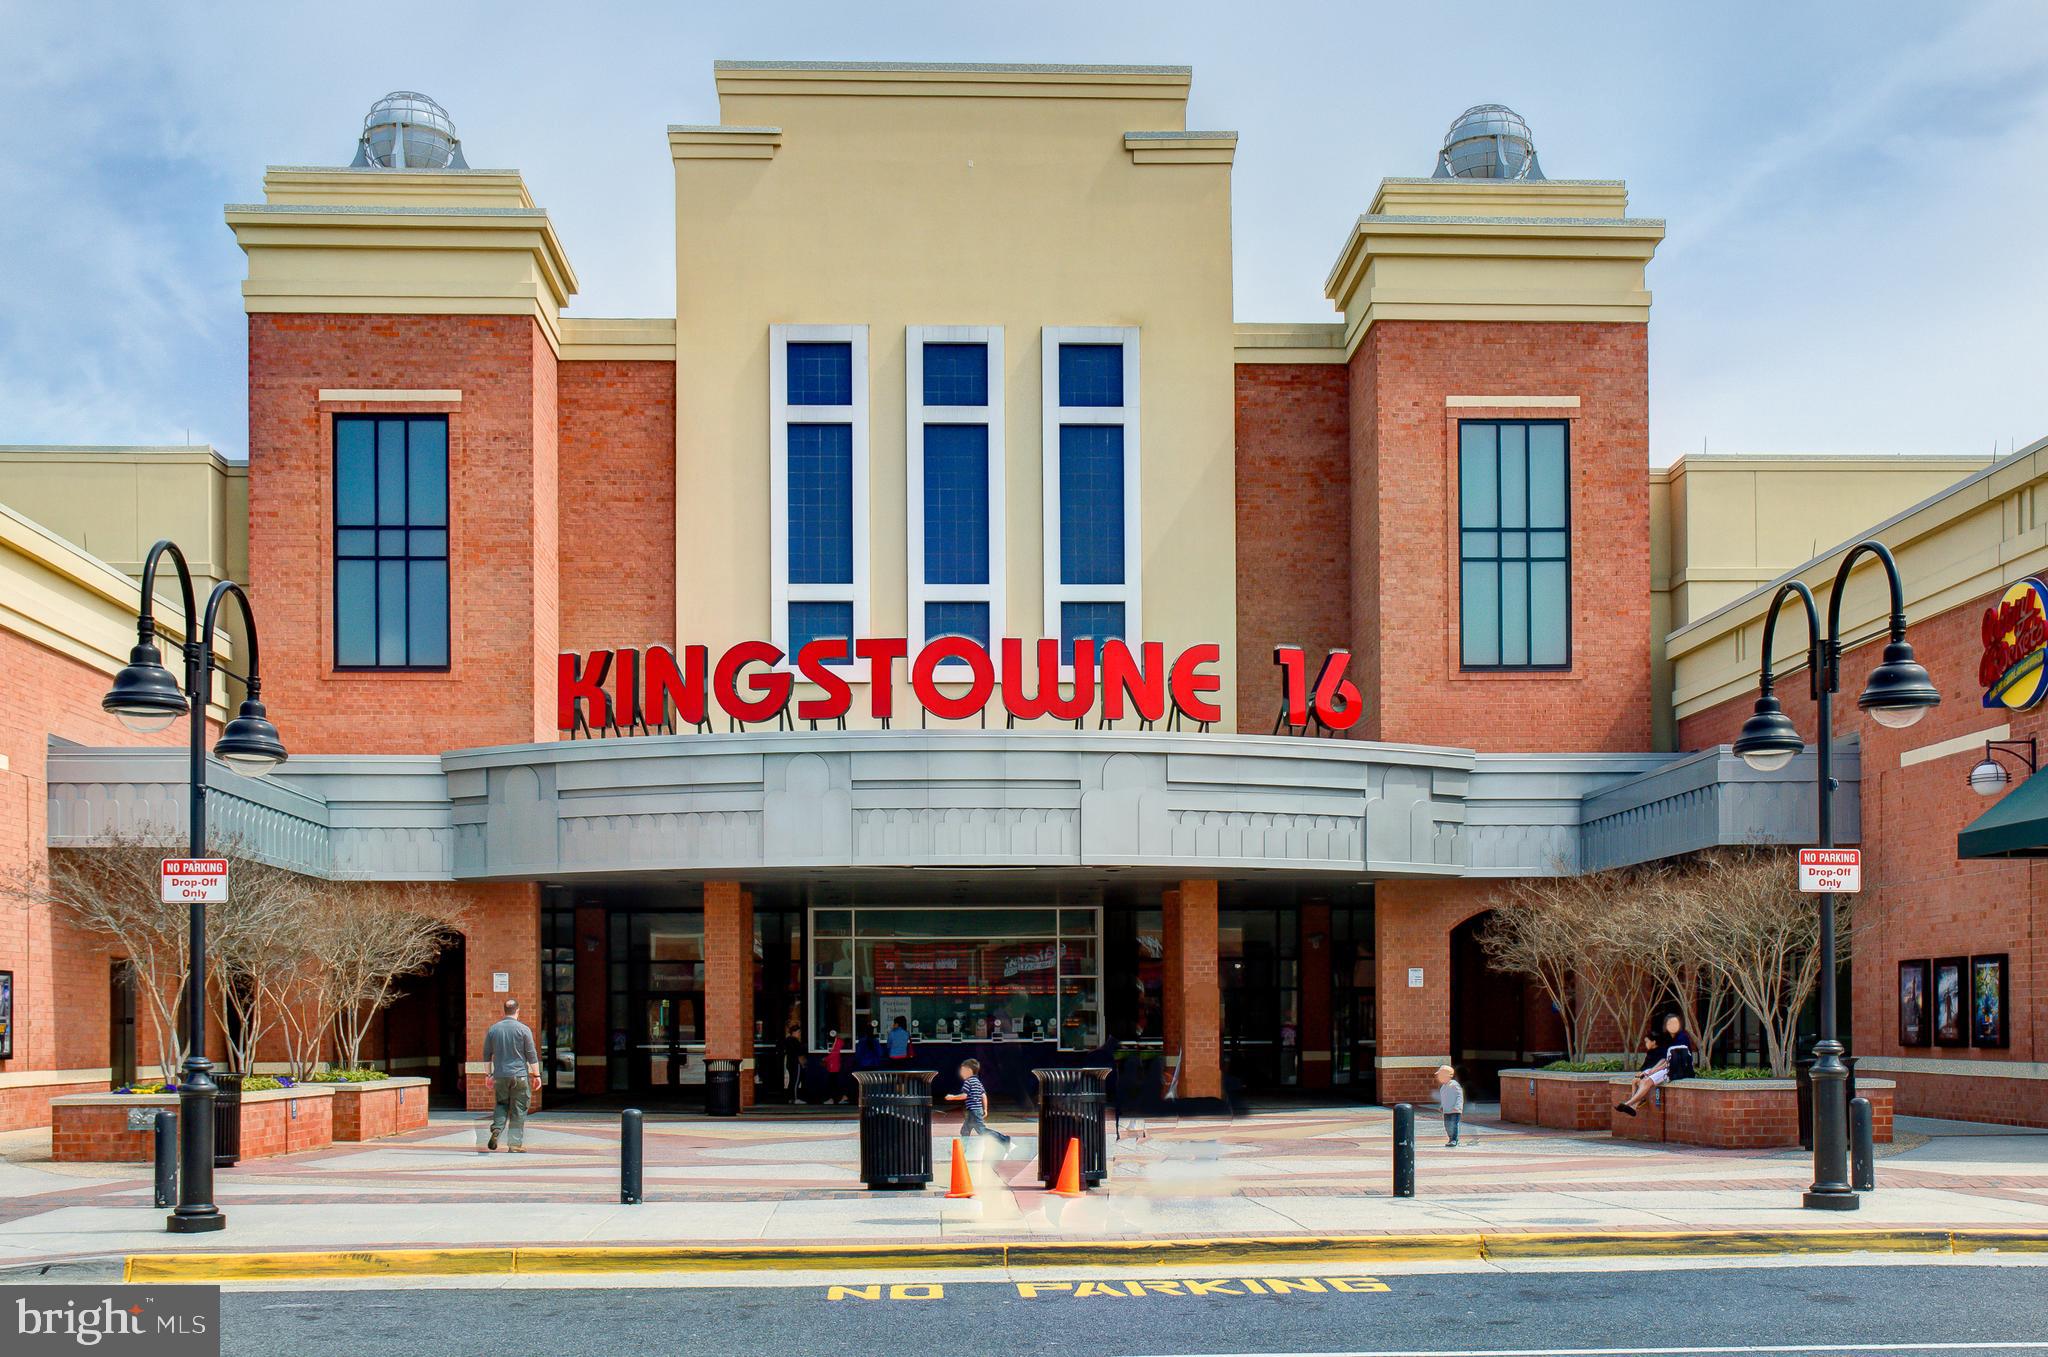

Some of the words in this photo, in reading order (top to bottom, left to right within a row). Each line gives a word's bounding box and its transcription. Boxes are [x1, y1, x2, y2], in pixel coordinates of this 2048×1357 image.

[558, 637, 1221, 731] KINGSTOWNE
[1274, 648, 1363, 731] 16
[1804, 853, 1816, 863] NO
[1819, 853, 1856, 863] PARKING
[167, 863, 180, 873] NO
[183, 863, 223, 873] PARKING
[1809, 868, 1851, 877] Drop-Off
[172, 878, 217, 888] Drop-Off
[1819, 879, 1841, 888] Only
[182, 889, 207, 899] Only
[827, 1284, 944, 1301] NO
[1015, 1277, 1392, 1298] PARKING
